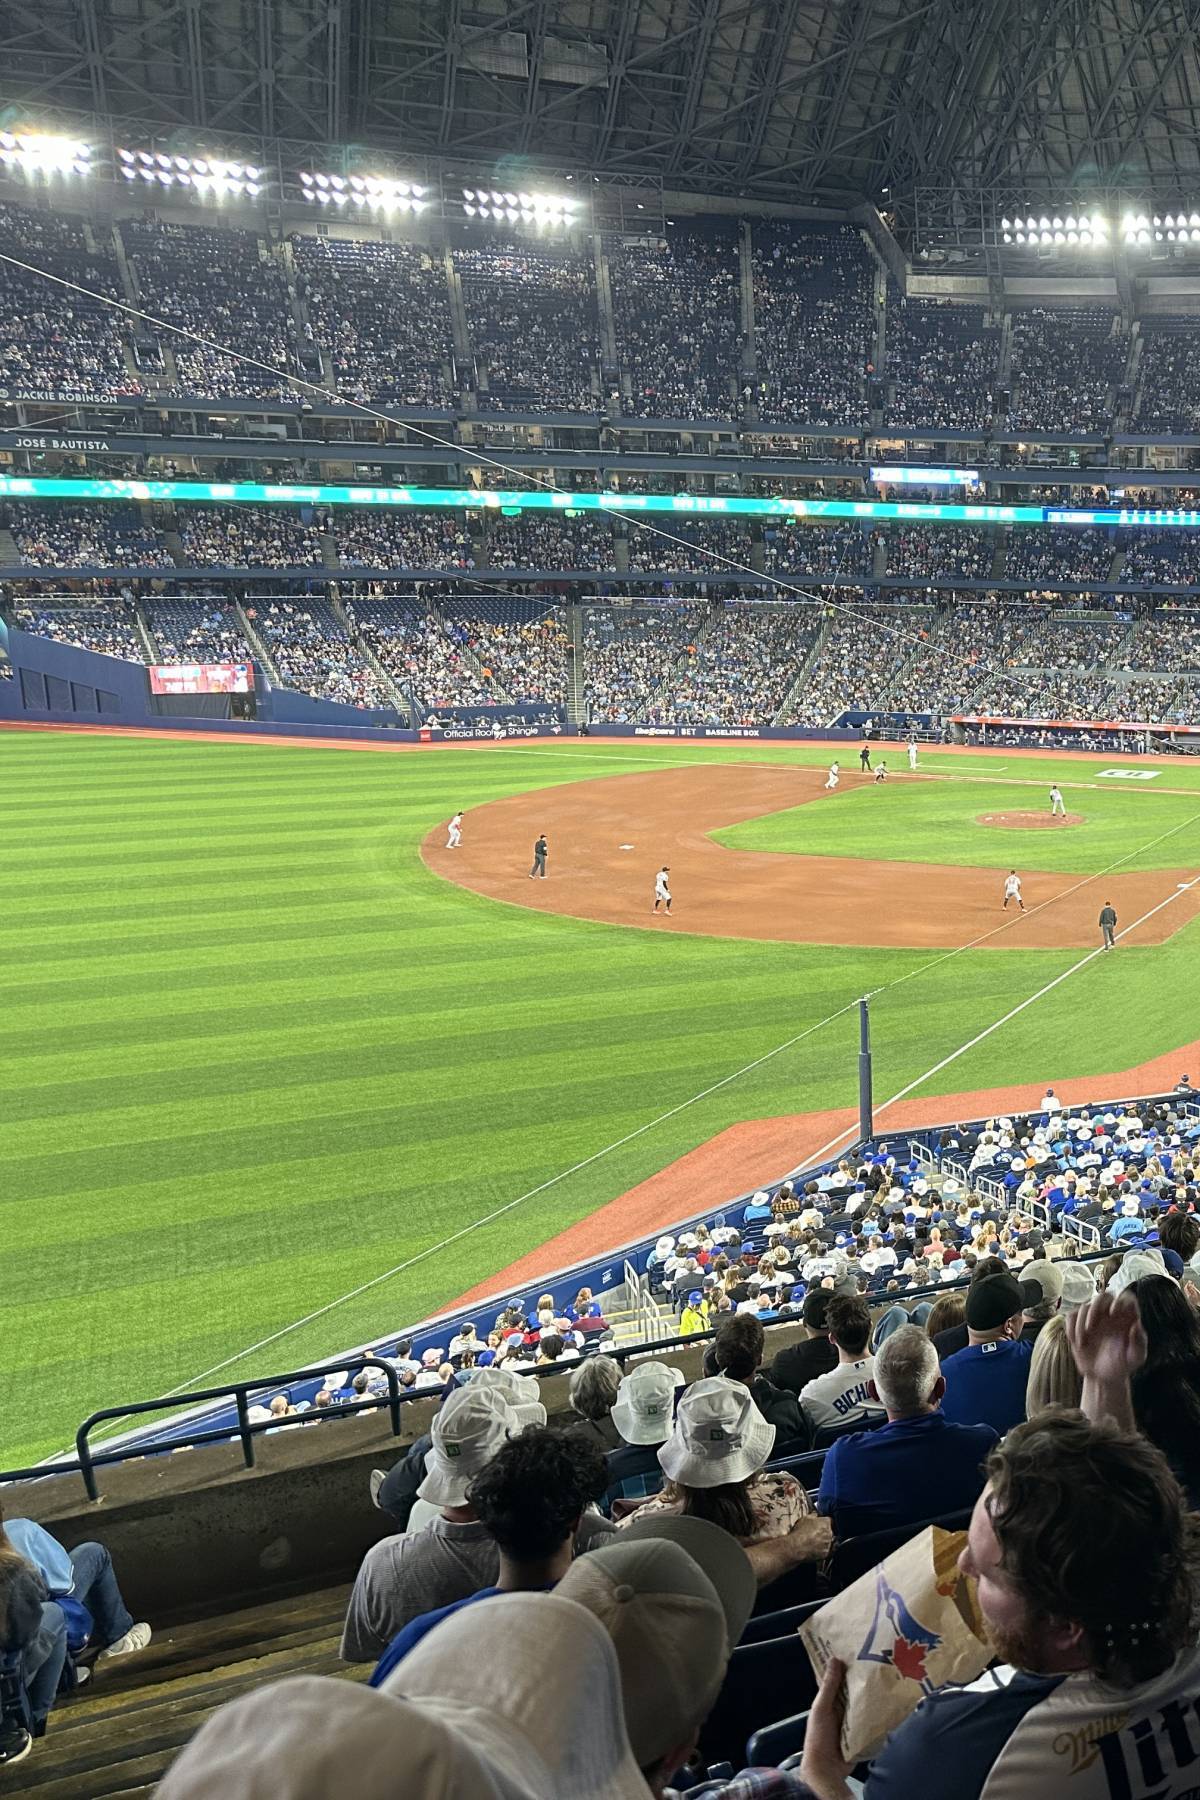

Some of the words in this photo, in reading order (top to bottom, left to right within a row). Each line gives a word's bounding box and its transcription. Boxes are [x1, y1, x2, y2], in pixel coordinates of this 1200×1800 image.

[16, 390, 55, 400] JACKIE
[59, 393, 118, 403] ROBINSON
[16, 438, 46, 448] JOSÉ
[52, 440, 109, 450] BAUTISTA
[444, 730, 473, 738] Official
[508, 727, 539, 736] Shingle
[635, 727, 675, 736] theScore
